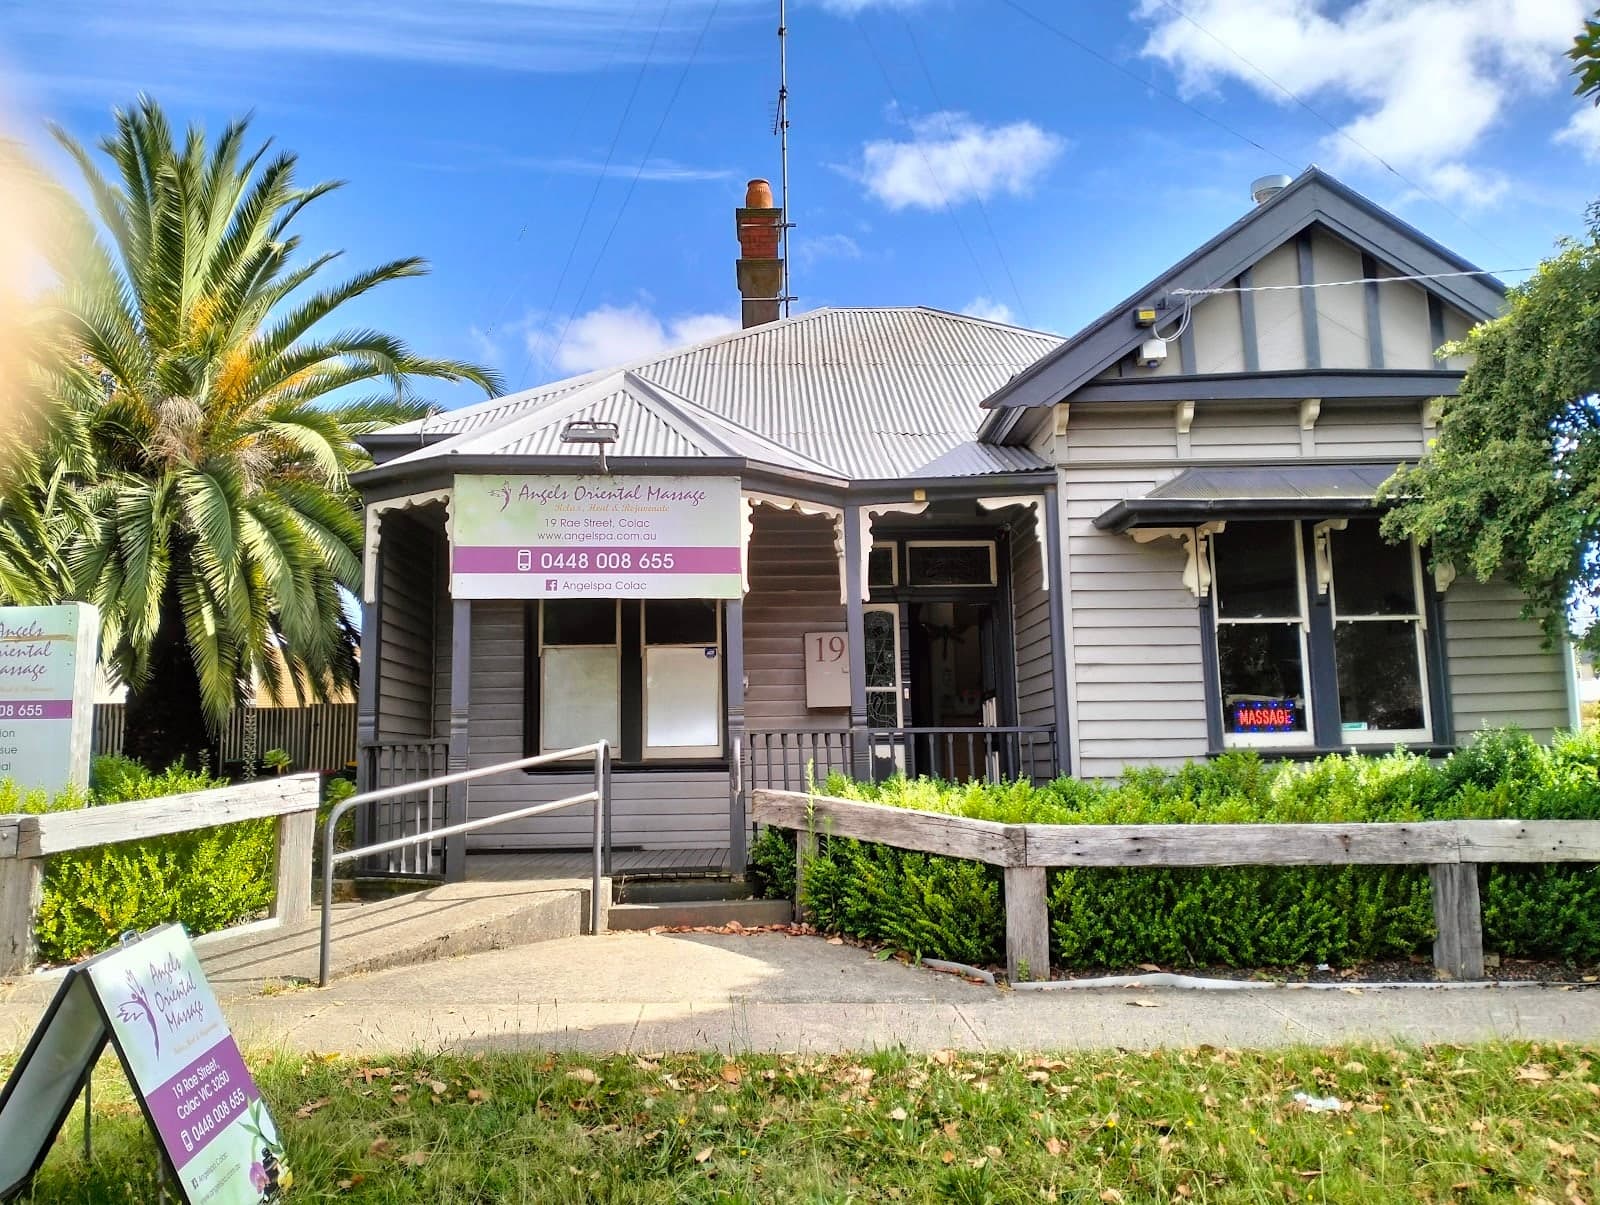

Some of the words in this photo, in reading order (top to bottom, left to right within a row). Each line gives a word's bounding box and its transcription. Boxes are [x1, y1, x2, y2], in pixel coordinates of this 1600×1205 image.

[518, 484, 569, 505] Angels
[574, 485, 642, 501] Oriental
[647, 486, 706, 506] Massage
[537, 530, 657, 542] www.angelspa.com.au
[545, 518, 557, 528] 19
[560, 518, 580, 528] Rae
[583, 518, 615, 530] Street,
[618, 518, 650, 528] Colac
[540, 553, 589, 569] 0448
[596, 553, 632, 569] 008
[639, 553, 675, 569] 655
[562, 581, 612, 592] Angelspa
[615, 581, 648, 590] Colac
[815, 636, 846, 662] 19
[18, 704, 43, 716] 655
[1239, 709, 1293, 725] MASSAGE
[149, 951, 182, 985] Angels
[154, 971, 198, 1013] Oriental
[165, 1000, 205, 1033] Massage
[172, 1083, 184, 1099] 19
[182, 1074, 199, 1093] Rae
[196, 1057, 221, 1081] Street,
[176, 1096, 201, 1120] Colac
[197, 1083, 213, 1102] VIC
[210, 1070, 230, 1092] 3250
[191, 1113, 215, 1142] 0448
[212, 1100, 231, 1123] 008
[228, 1087, 246, 1109] 655
